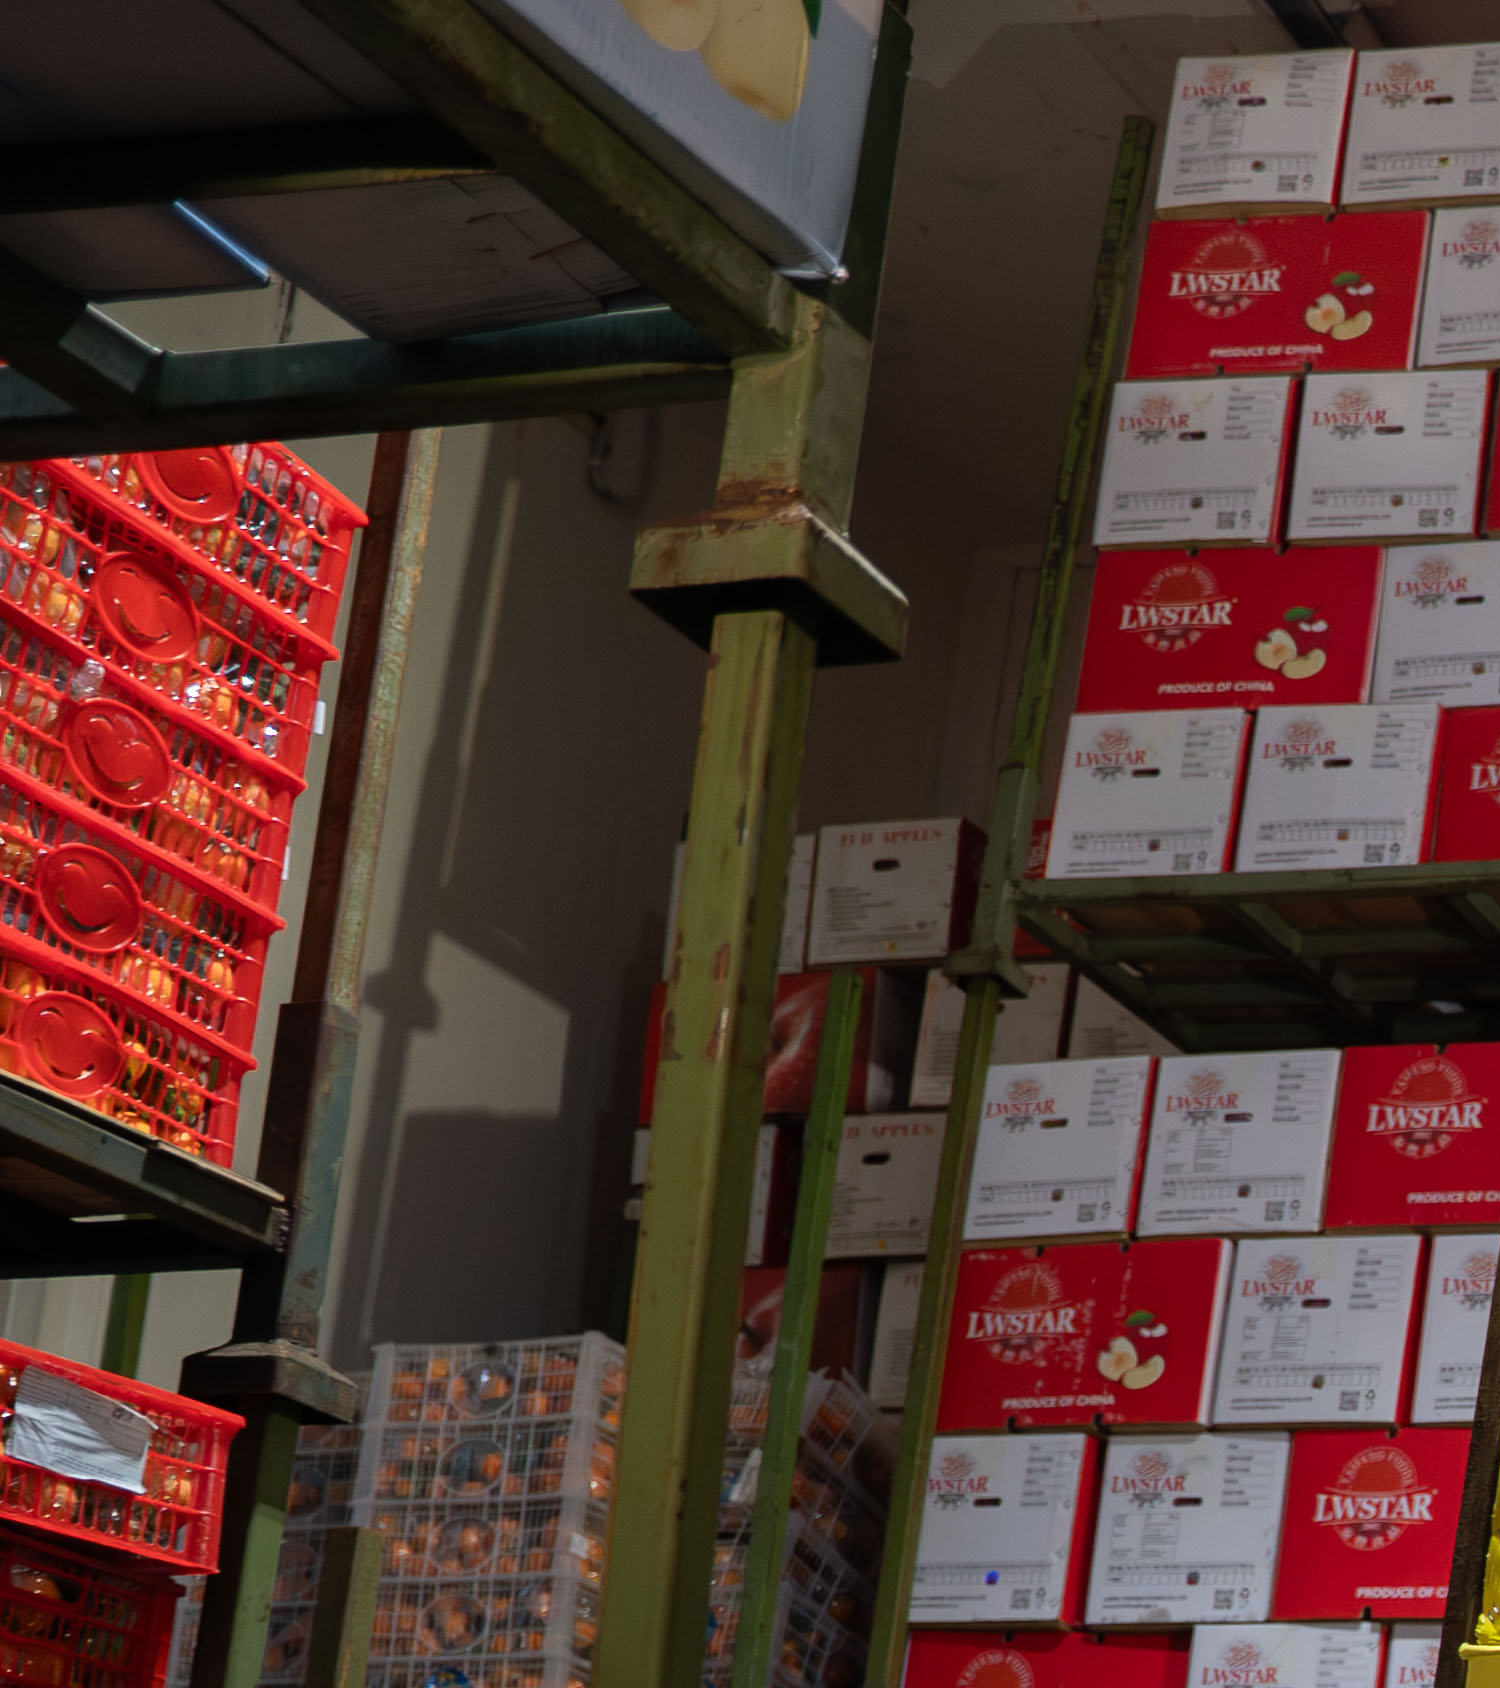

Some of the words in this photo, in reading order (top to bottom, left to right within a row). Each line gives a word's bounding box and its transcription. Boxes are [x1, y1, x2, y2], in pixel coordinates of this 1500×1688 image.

[1169, 268, 1281, 299] LWSTAR
[1119, 601, 1232, 630] LWSTAR
[1366, 1101, 1482, 1132] LWSTAR
[966, 1307, 1076, 1339] LWSTAR
[1314, 1492, 1433, 1522] LWSTAR
